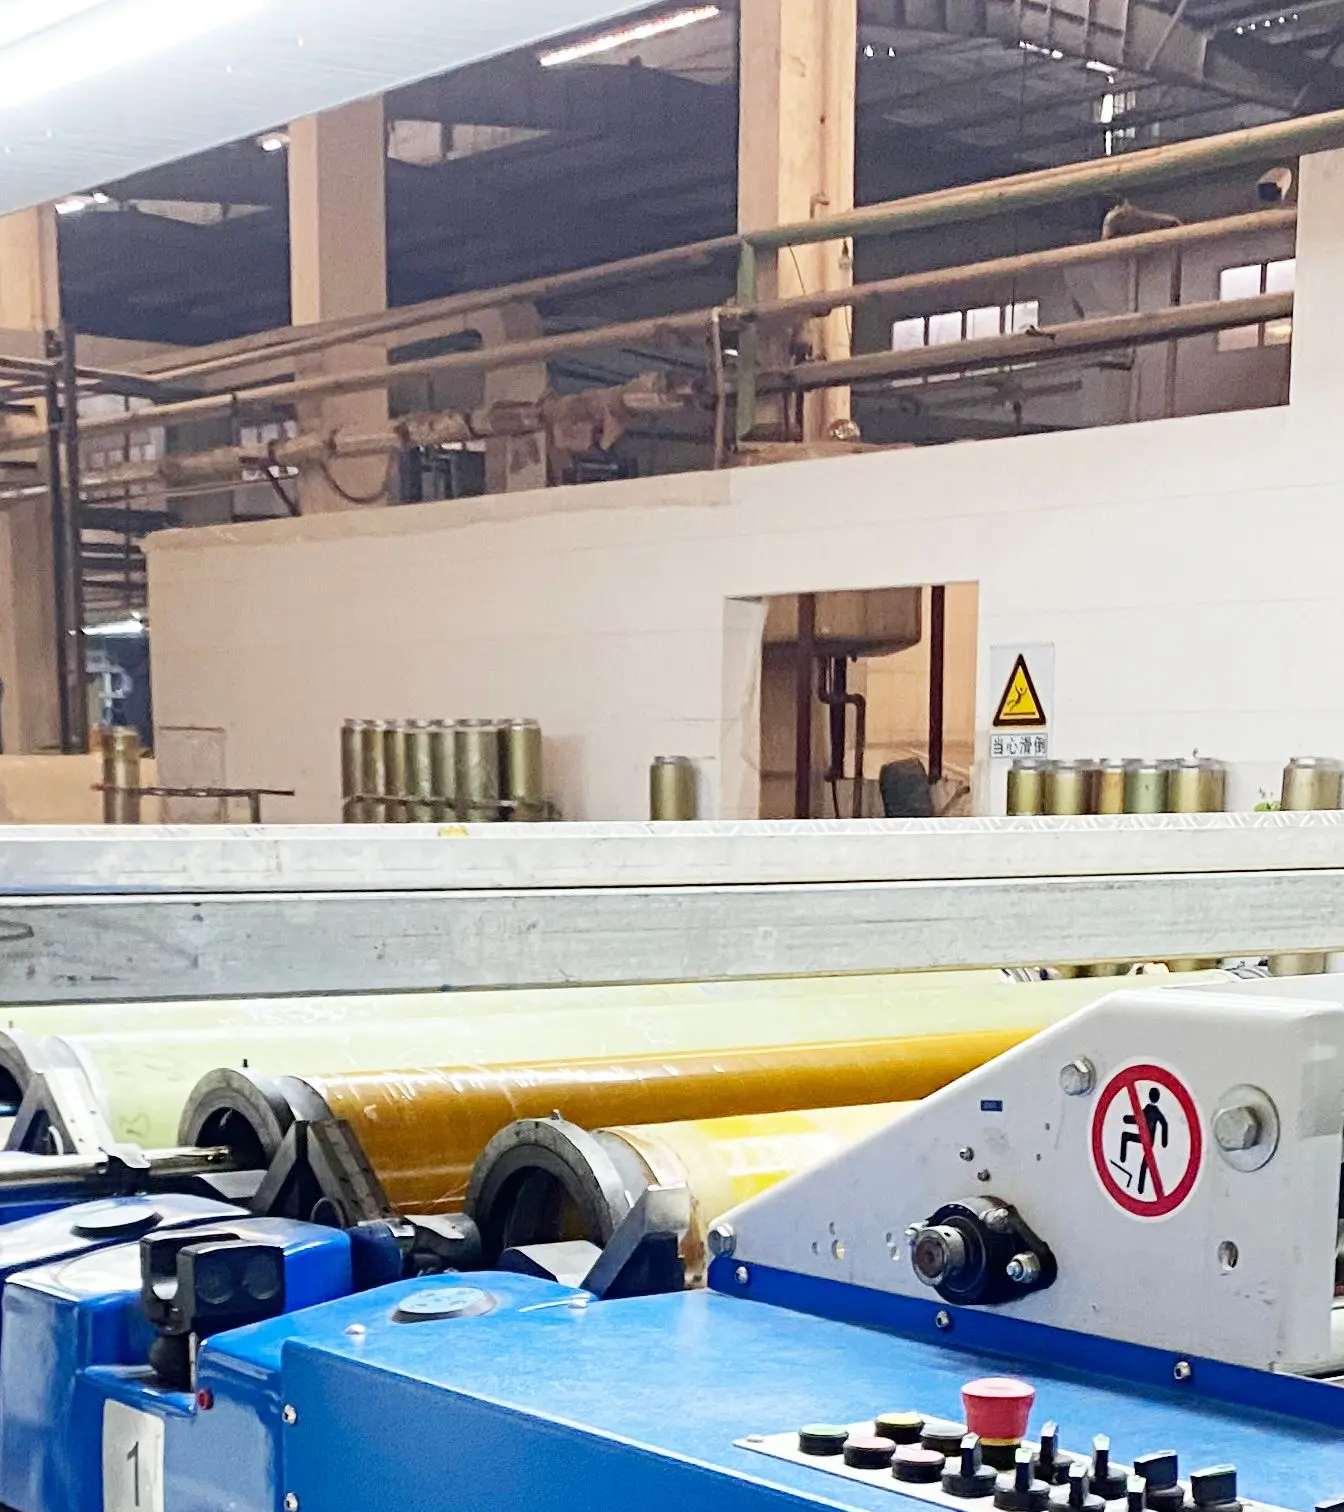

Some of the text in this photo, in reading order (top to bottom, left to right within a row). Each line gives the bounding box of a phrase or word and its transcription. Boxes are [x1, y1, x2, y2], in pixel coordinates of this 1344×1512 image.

[993, 736, 1047, 755] 当心滑倒
[126, 1440, 140, 1507] 1
